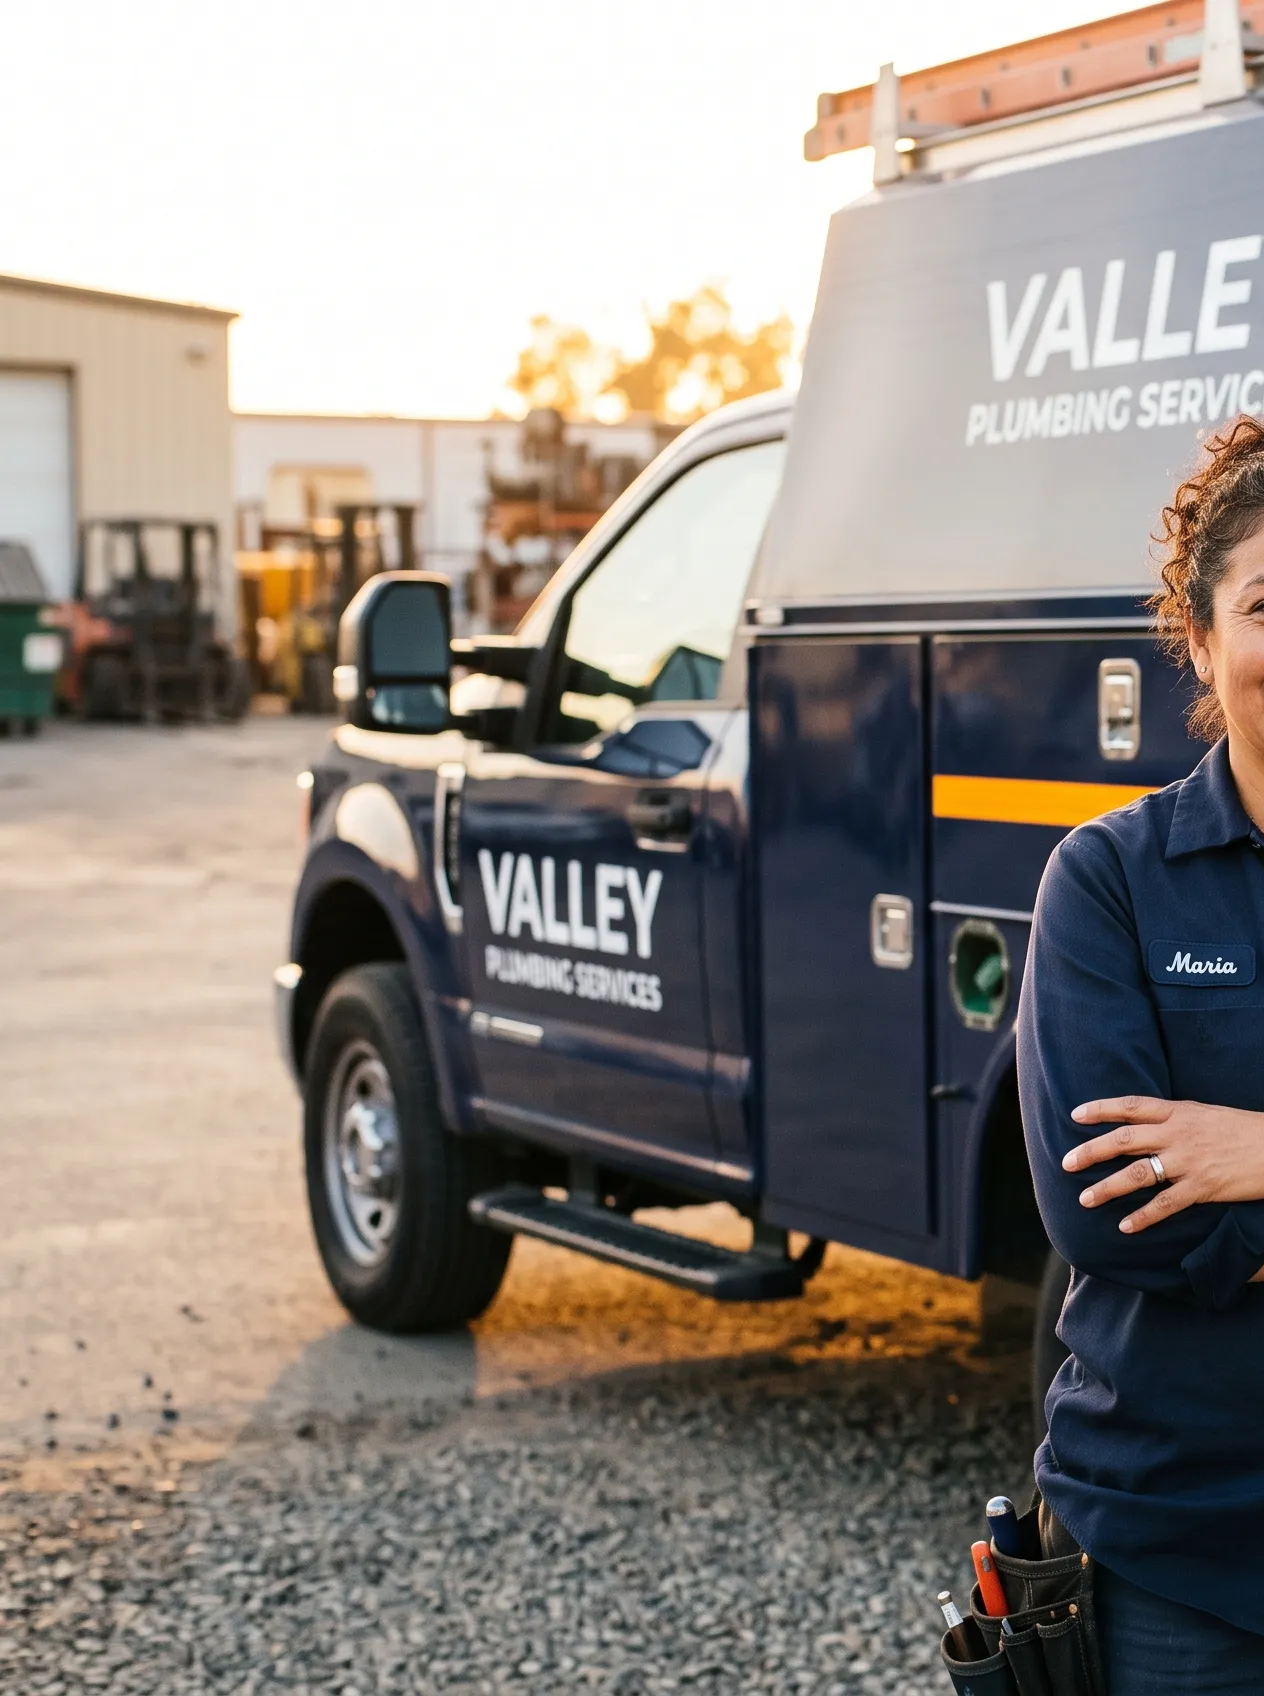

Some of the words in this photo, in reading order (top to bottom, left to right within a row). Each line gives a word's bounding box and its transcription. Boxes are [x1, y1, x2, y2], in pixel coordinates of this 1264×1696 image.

[965, 386, 1133, 446] PLUMBING
[478, 848, 663, 960] VALLEY
[485, 944, 575, 996] PLUMBING
[574, 960, 663, 1013] SERVICES
[1165, 951, 1238, 974] Maria
